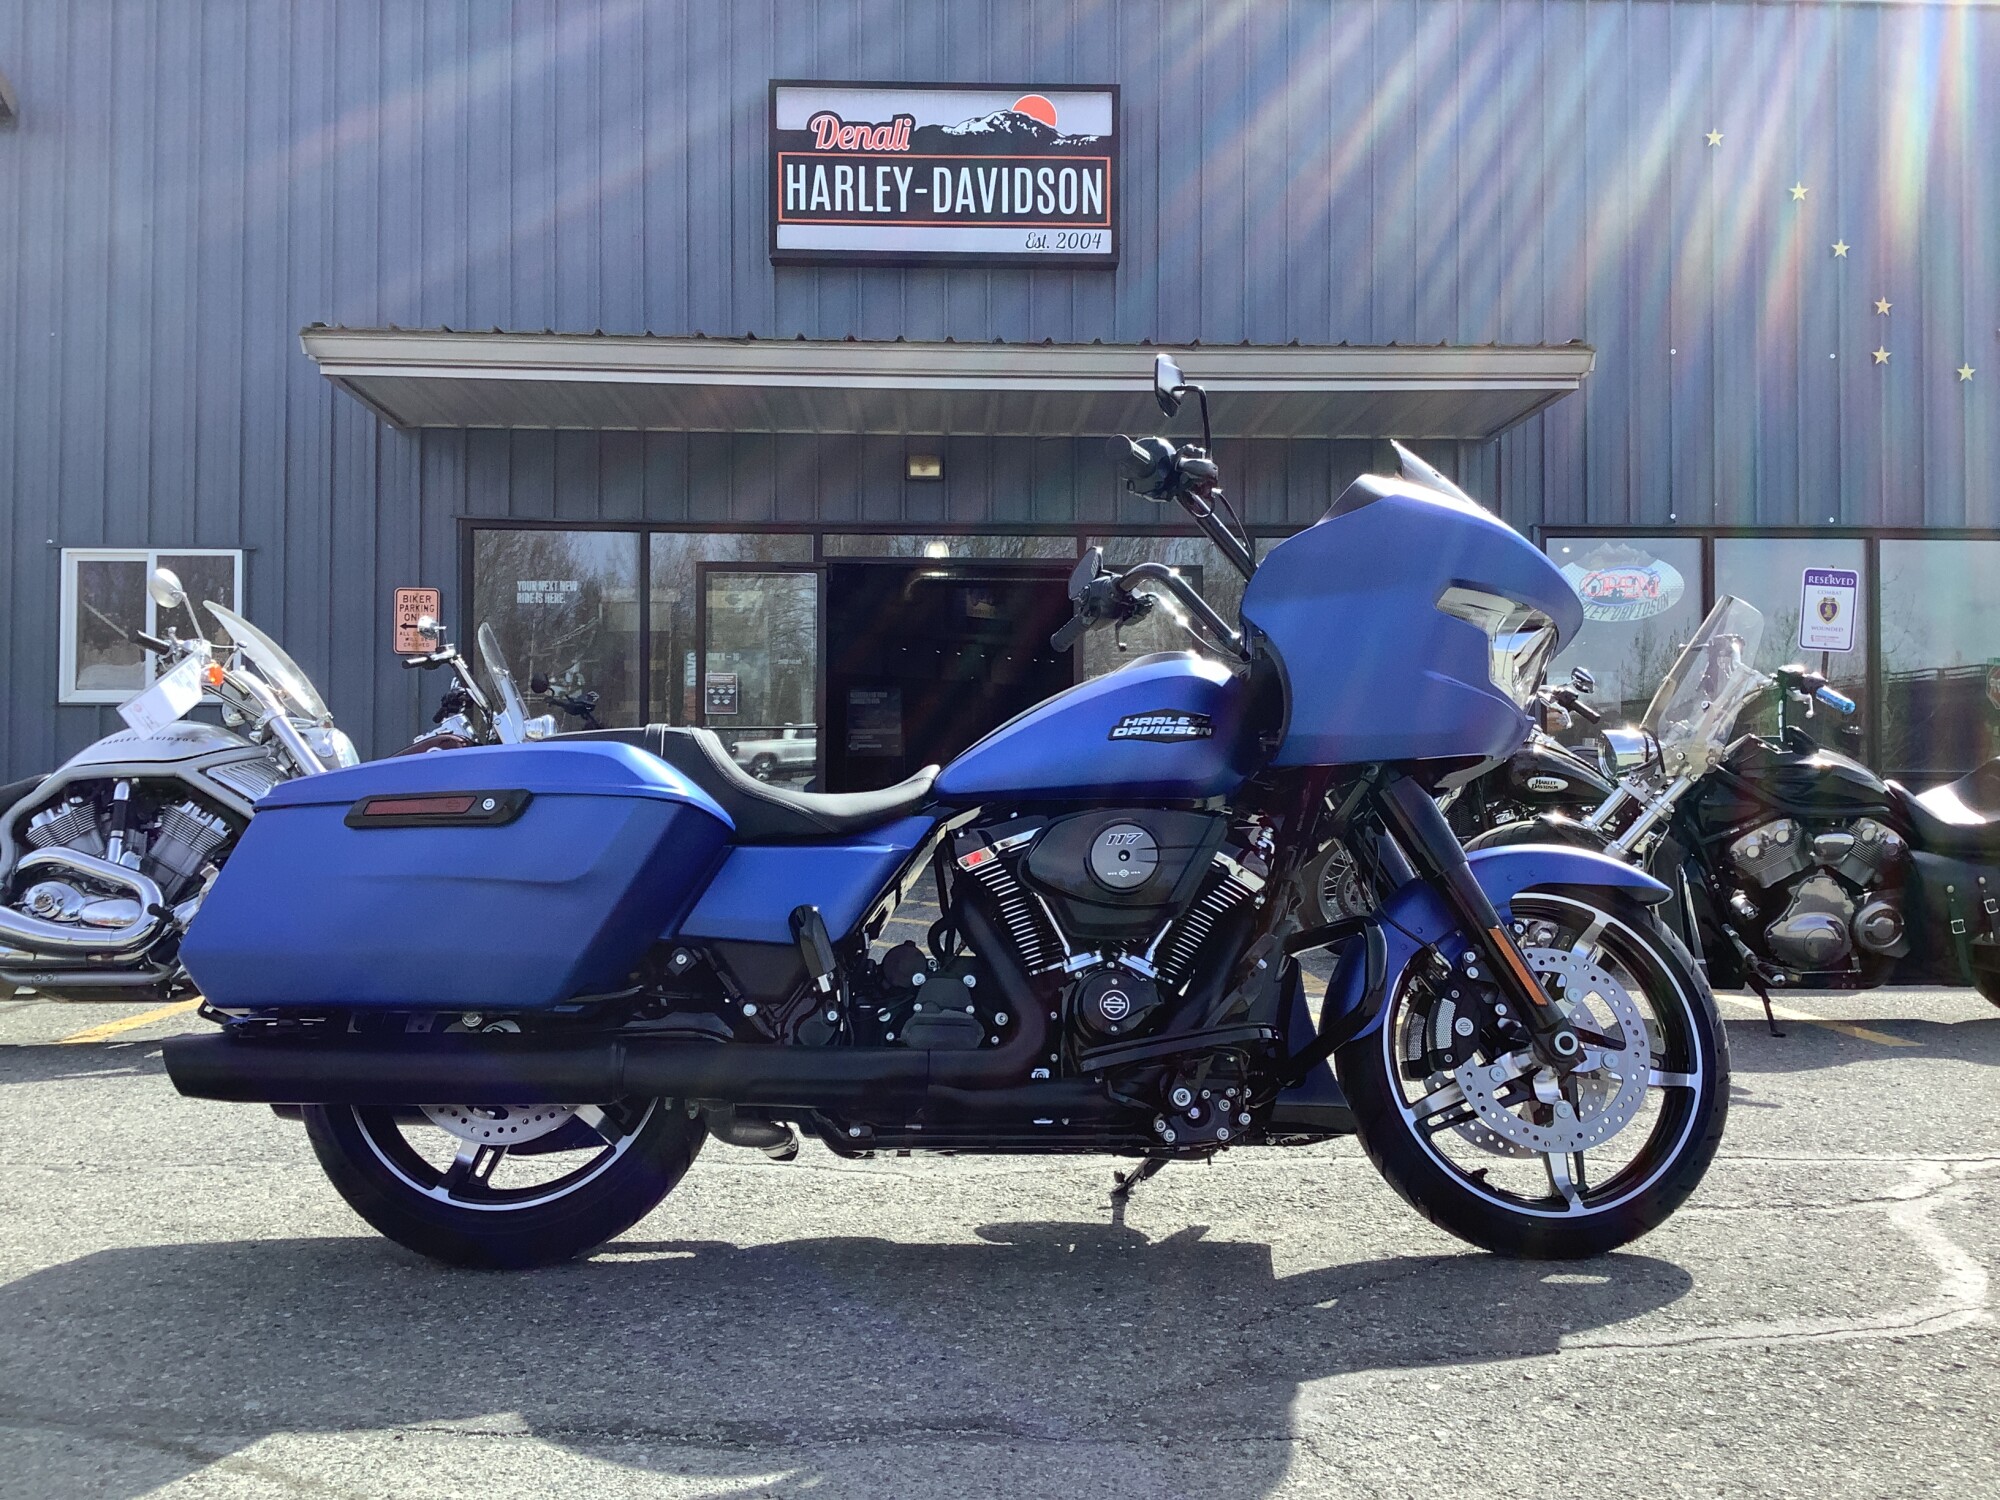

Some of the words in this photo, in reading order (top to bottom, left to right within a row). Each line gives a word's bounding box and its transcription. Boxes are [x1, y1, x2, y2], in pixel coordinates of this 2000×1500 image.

[810, 114, 912, 151] Denali
[786, 163, 1102, 215] HARLEY-DAVIDSON
[1025, 231, 1050, 249] Est.
[1056, 231, 1102, 249] 2004
[517, 580, 537, 591] YOUR
[538, 580, 558, 591] NEXT
[560, 580, 578, 591] NEW
[1582, 571, 1659, 600] OPEN
[1808, 574, 1854, 586] RESERVED
[402, 594, 432, 603] BIKER
[517, 592, 535, 603] RIDE
[535, 592, 543, 603] IS
[399, 604, 435, 613] PARKING
[1112, 725, 1212, 737] DAVIDSON
[1106, 832, 1143, 845] 117
